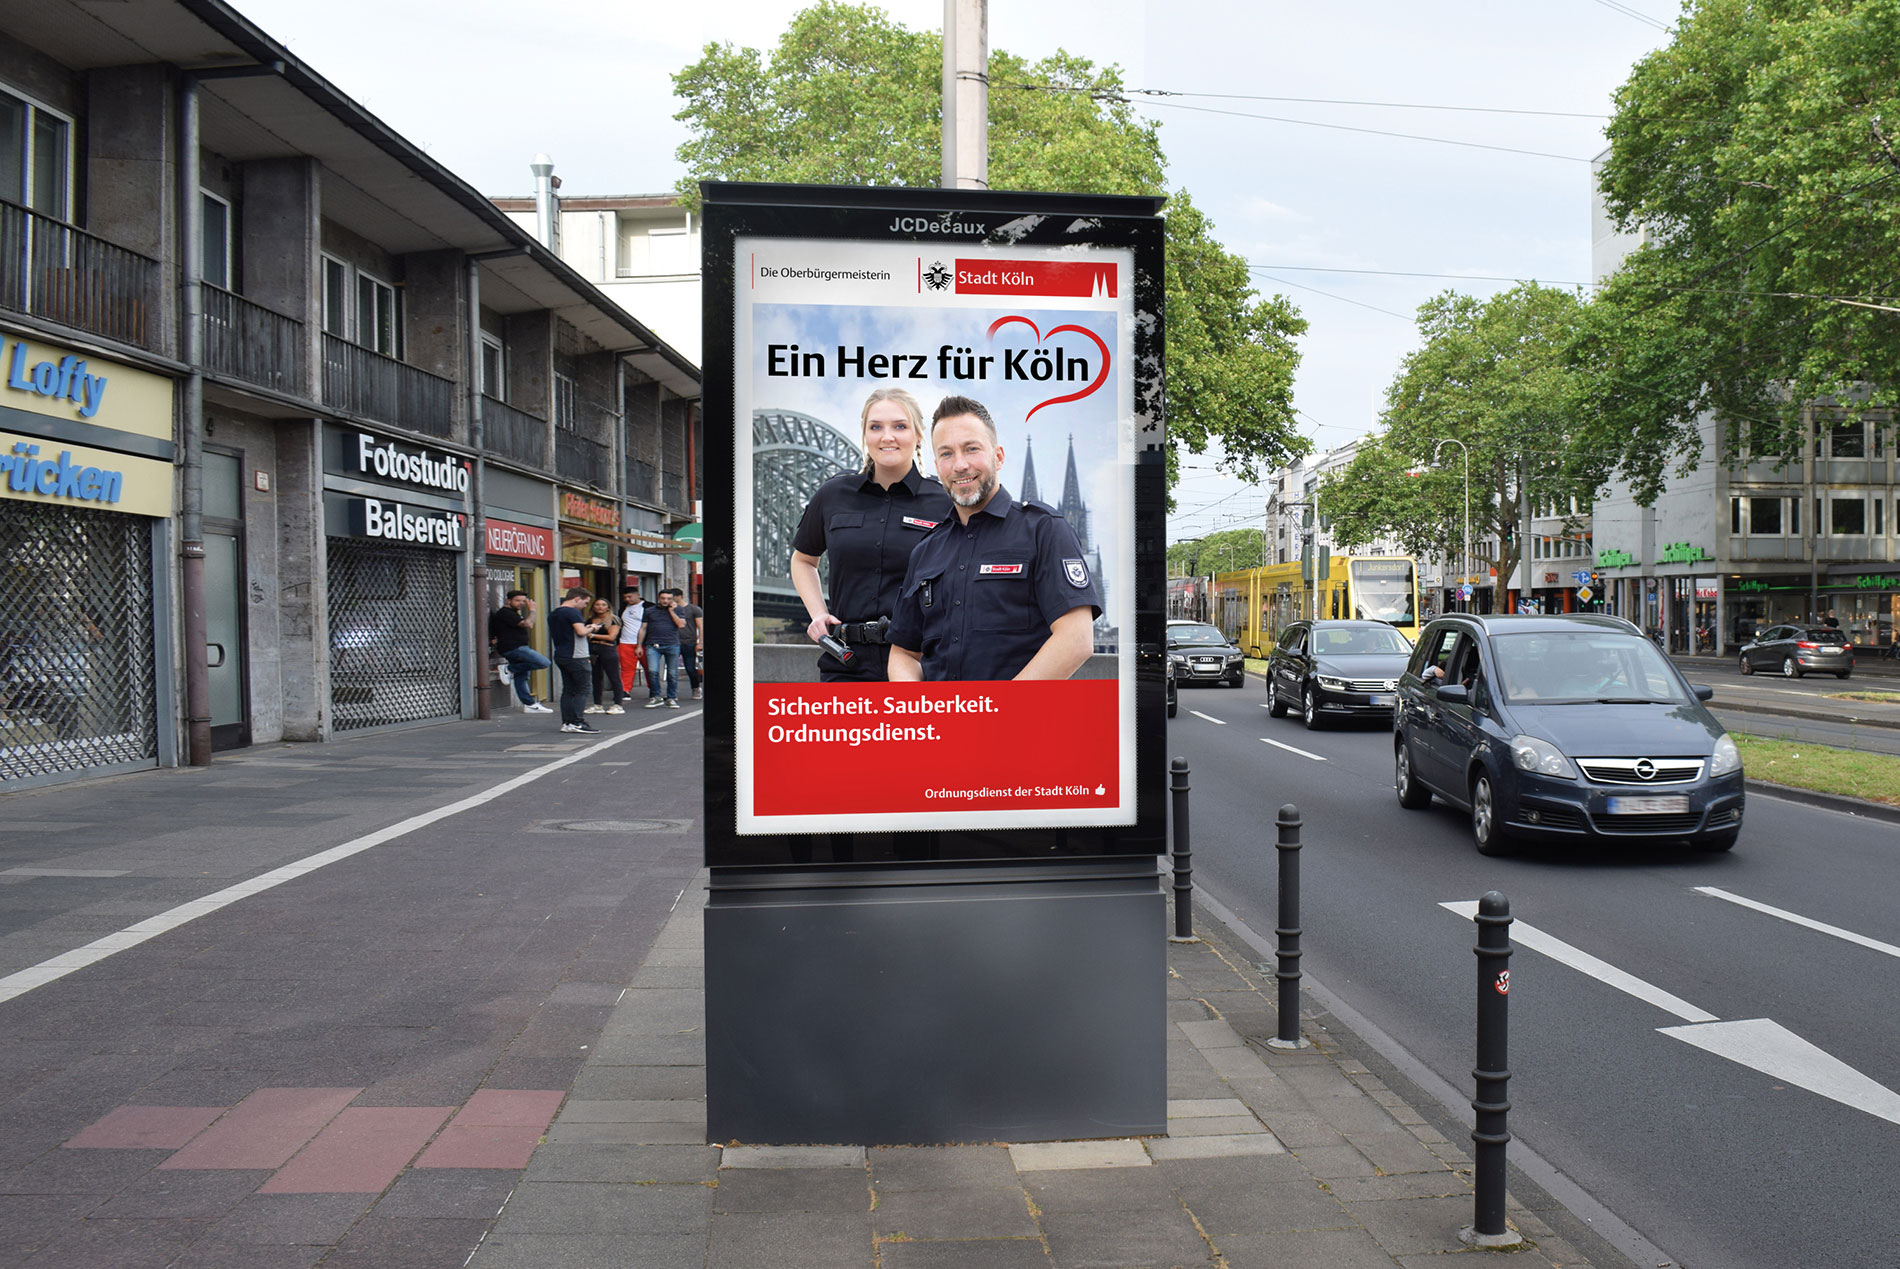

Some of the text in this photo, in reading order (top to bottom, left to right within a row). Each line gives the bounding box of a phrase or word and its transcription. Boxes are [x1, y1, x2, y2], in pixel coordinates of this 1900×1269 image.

[889, 217, 986, 235] JCDecaux
[760, 266, 891, 283] Die Oberbürgermeisterin
[959, 270, 1035, 287] Stadt Köln
[767, 344, 1090, 382] Ein Herz für Köln
[8, 341, 108, 418] Lofty
[358, 433, 471, 493] Fotostudio
[365, 498, 463, 548] Balsereit
[488, 527, 545, 557] NEUERÖFFNUNG
[1367, 563, 1405, 571] Junkersdorf
[768, 695, 999, 715] Sicherheit. Sauberkeit.
[768, 723, 941, 746] Ordnungsdienst.
[925, 785, 1089, 800] Ordnungsdienst der Stadt Köln
